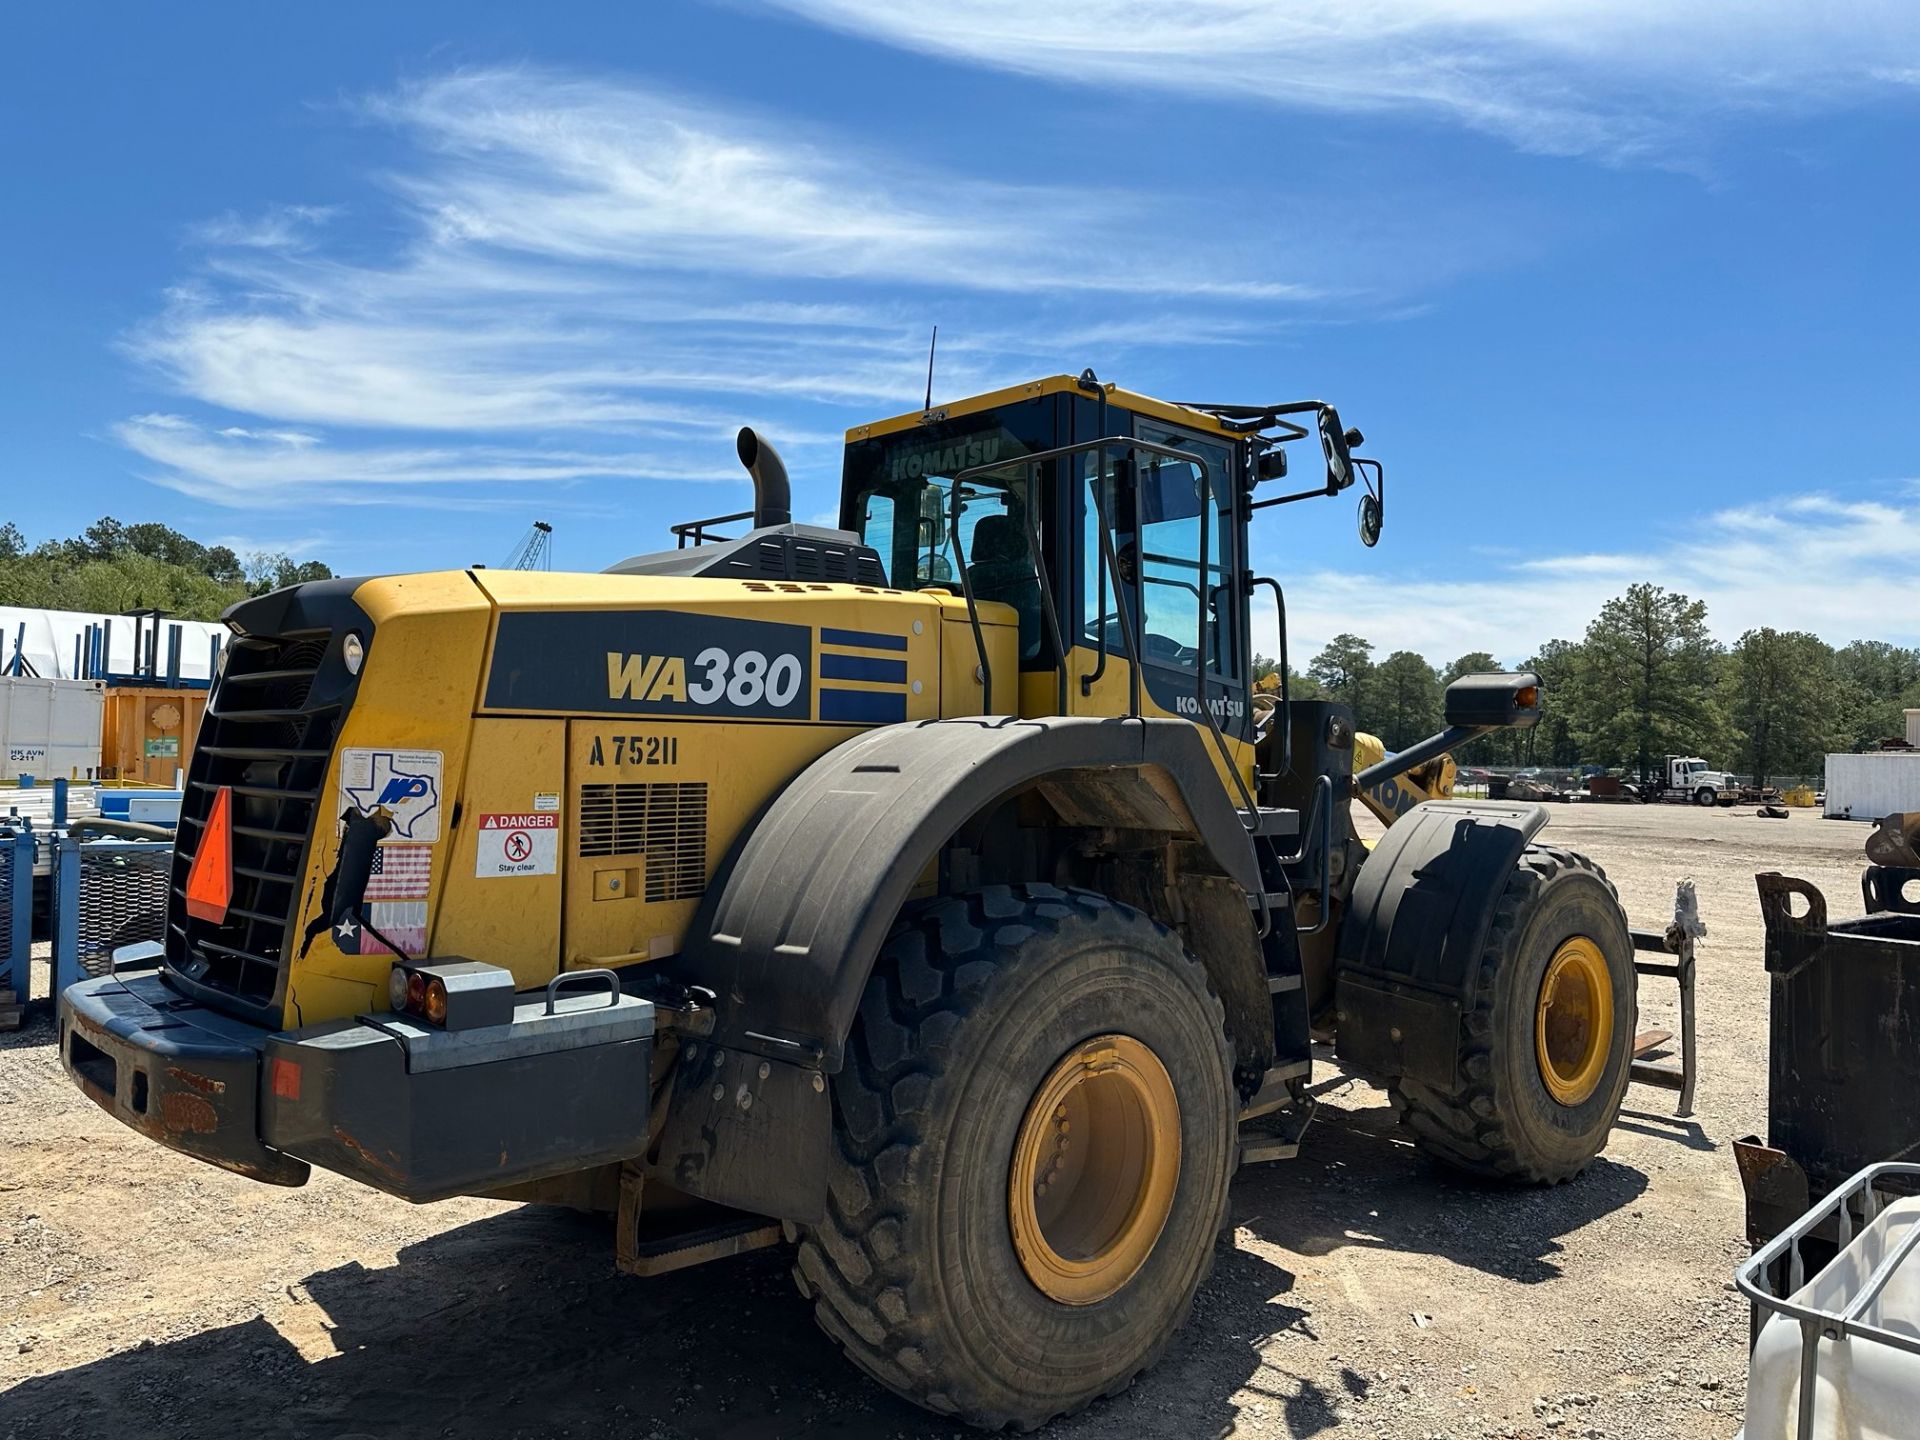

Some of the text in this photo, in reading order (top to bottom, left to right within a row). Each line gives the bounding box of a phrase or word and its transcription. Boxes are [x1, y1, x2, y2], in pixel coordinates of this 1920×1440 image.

[891, 435, 1000, 480] KOMATSU
[607, 647, 802, 708] WA380
[589, 736, 678, 766] A 75211
[500, 815, 554, 828] DANGER
[498, 863, 536, 873] Stay clear
